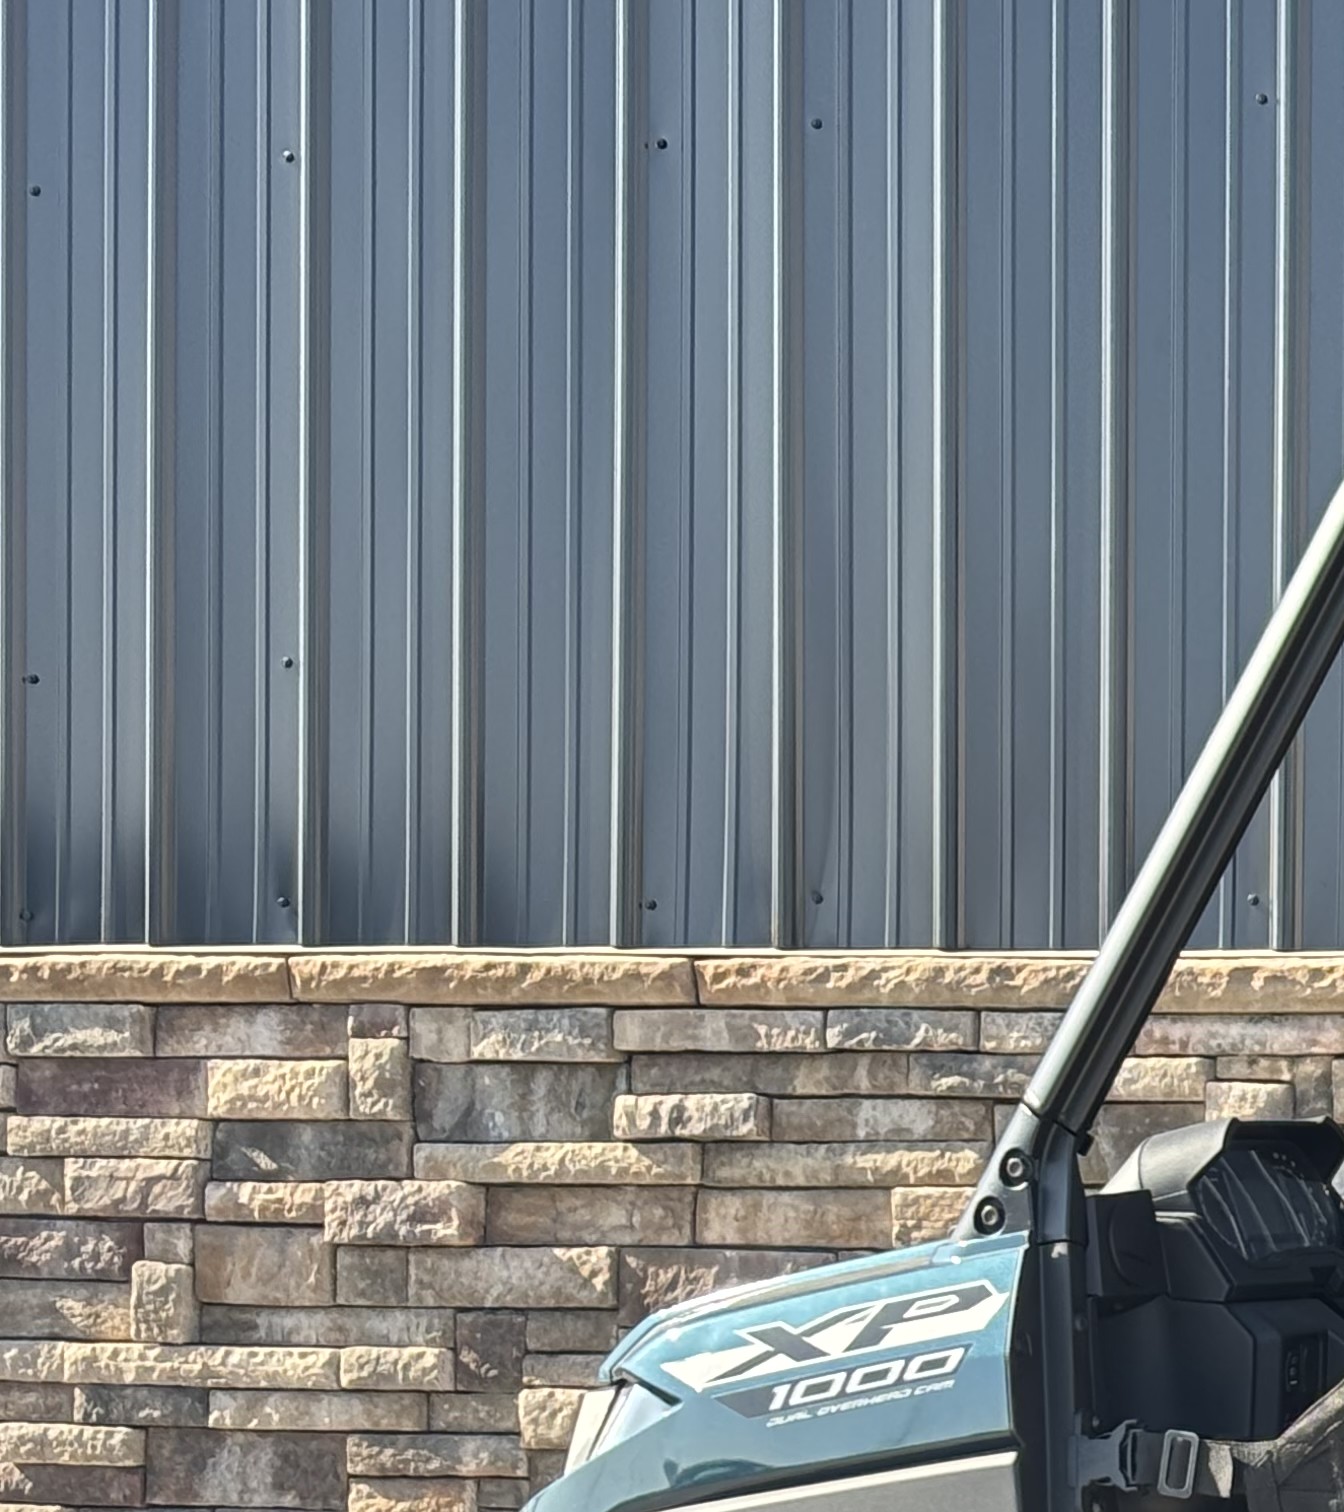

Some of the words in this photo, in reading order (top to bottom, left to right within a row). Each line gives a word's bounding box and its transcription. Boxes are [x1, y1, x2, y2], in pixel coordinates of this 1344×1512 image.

[703, 1281, 998, 1385] XP
[765, 1409, 813, 1428] DUAL
[817, 1388, 912, 1417] OVERHEAD
[914, 1379, 956, 1396] CAM
[769, 1347, 967, 1411] 1000
